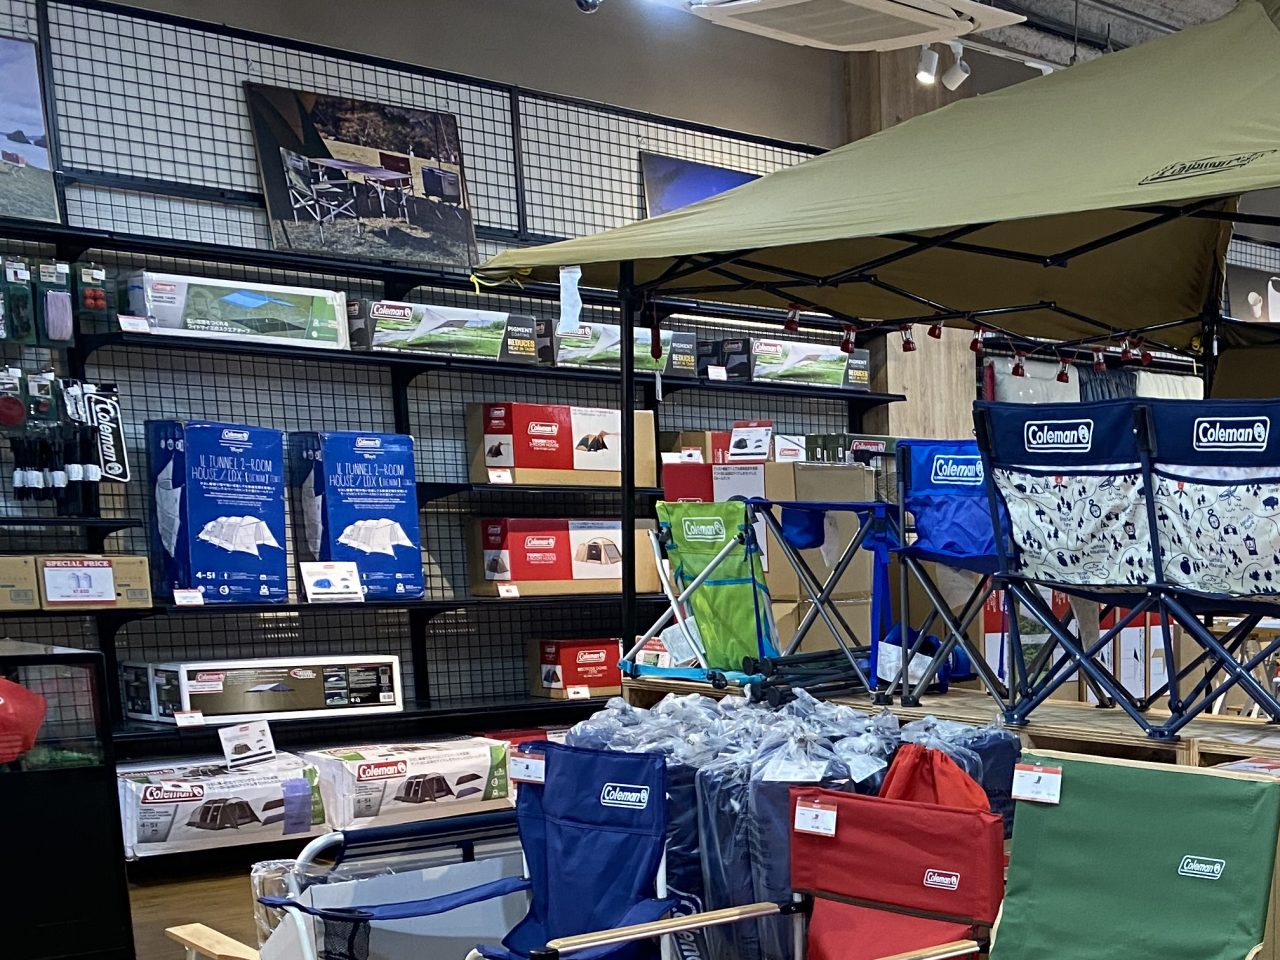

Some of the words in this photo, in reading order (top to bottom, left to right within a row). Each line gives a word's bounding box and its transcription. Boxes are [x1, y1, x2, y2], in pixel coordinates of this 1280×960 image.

[373, 304, 404, 317] Coleman
[96, 403, 117, 461] Coleman
[1029, 425, 1078, 445] Coleman
[1199, 422, 1254, 442] Coleman
[209, 455, 238, 470] TUNNEL
[240, 458, 272, 472] 2-ROOM
[345, 463, 372, 475] TUNNEL
[373, 464, 404, 476] 2-ROOM
[936, 459, 976, 477] Coleman
[685, 519, 716, 536] Coleman
[359, 764, 398, 778] Coleman
[603, 785, 640, 803] Coleman
[1183, 858, 1215, 874] Coleman
[927, 872, 952, 885] Coleman
